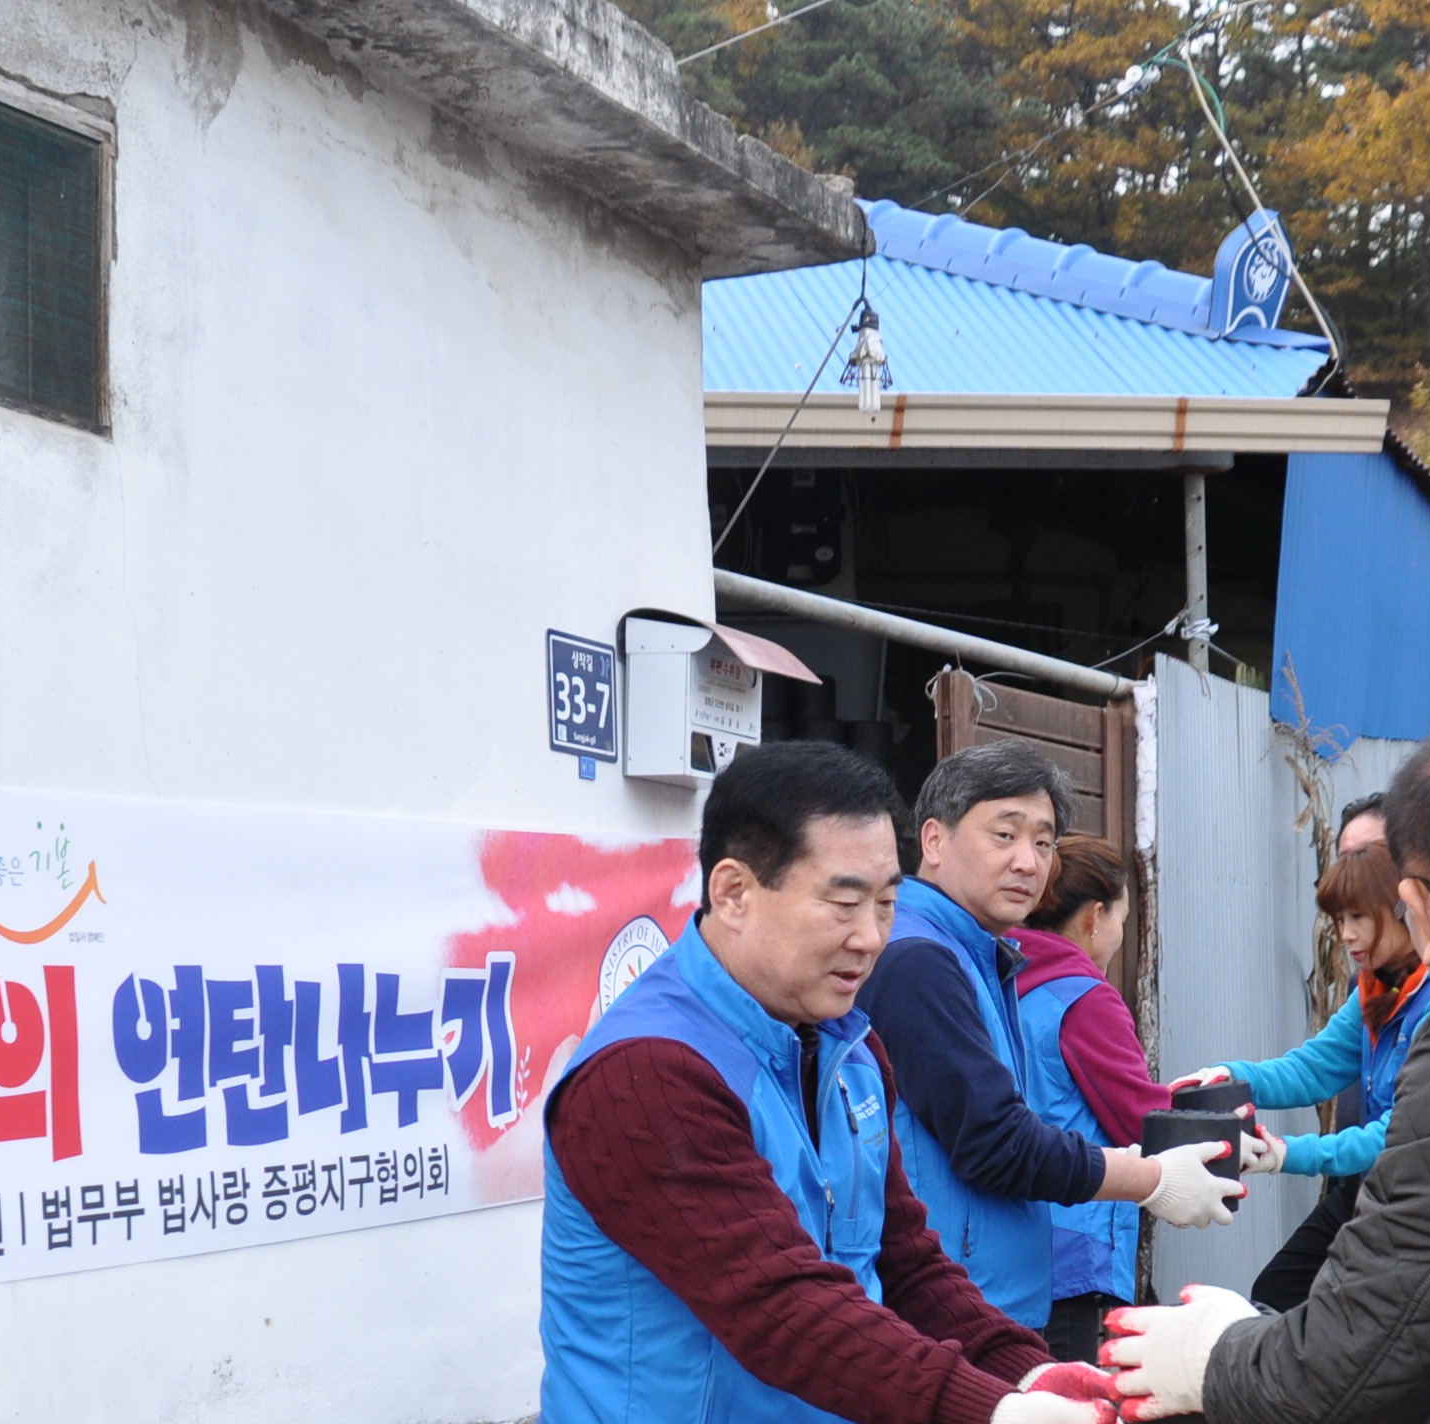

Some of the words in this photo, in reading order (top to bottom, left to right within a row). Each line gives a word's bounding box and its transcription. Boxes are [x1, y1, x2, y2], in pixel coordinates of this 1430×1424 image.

[555, 672, 610, 729] 33-7
[29, 836, 74, 890] 기본
[636, 924, 649, 940] OF
[112, 960, 514, 1157] 연탄나누기
[41, 1178, 146, 1251] 법무부
[157, 1166, 251, 1236] 법사랑
[261, 1142, 451, 1222] 증평지구협의회
